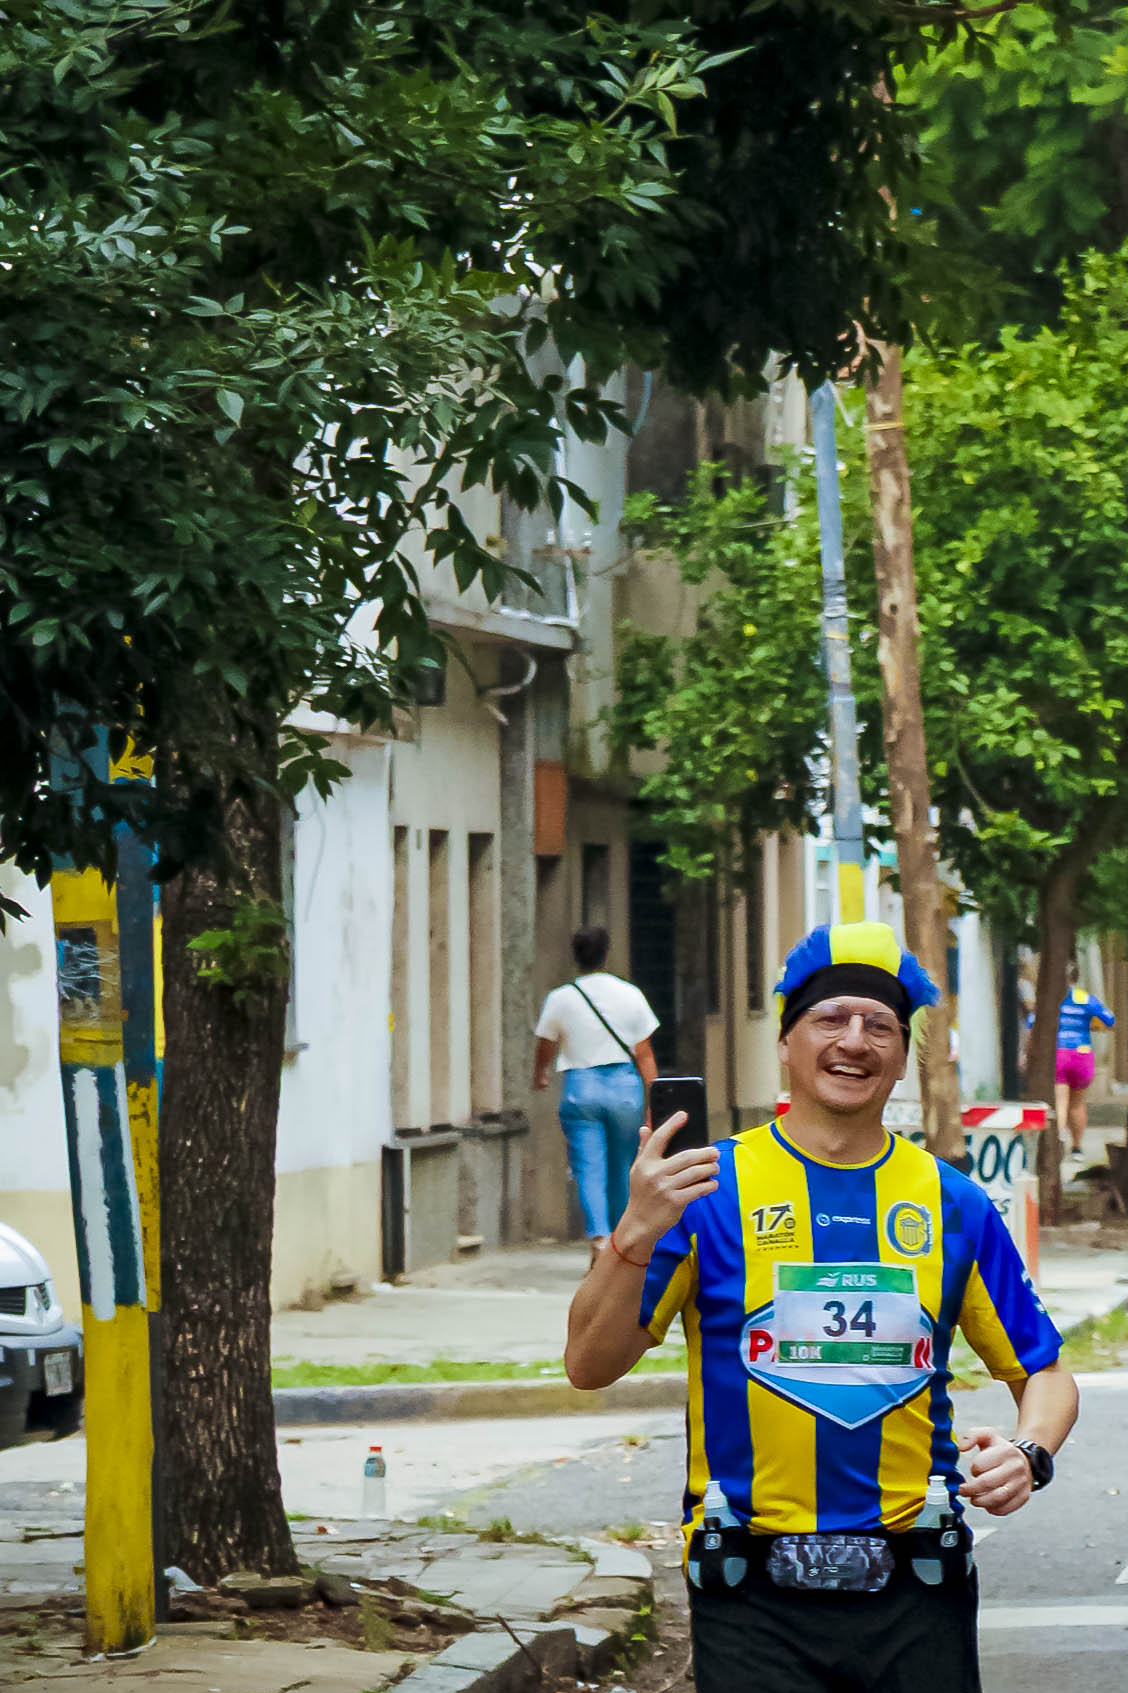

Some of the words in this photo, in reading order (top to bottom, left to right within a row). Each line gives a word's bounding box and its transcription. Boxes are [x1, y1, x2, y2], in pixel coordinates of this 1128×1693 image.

[841, 1273, 877, 1288] RUS
[822, 1300, 876, 1338] 34
[789, 1346, 822, 1360] 10K
